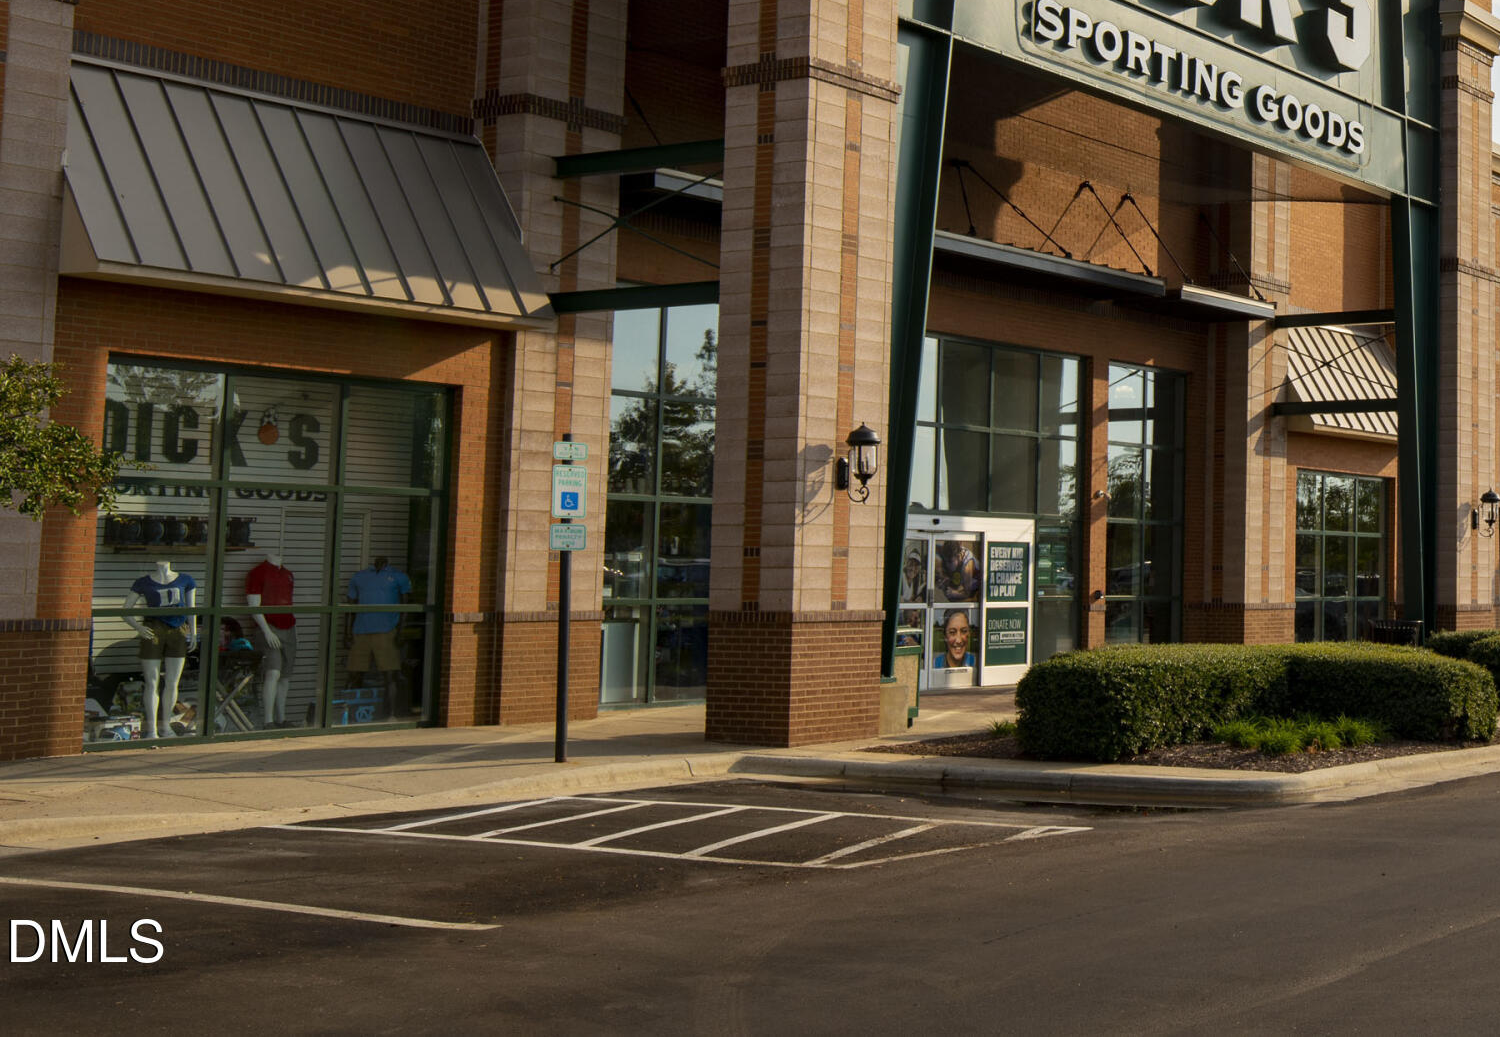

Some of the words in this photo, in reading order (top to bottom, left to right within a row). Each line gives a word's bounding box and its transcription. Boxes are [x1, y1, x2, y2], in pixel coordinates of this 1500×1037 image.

[1256, 84, 1366, 155] GOODS
[991, 547, 1011, 559] EVERY
[991, 560, 1023, 572] DESERVES
[990, 572, 995, 584] A
[996, 573, 1023, 584] CHANCE
[991, 585, 999, 597] TO
[999, 585, 1016, 597] PLAY
[988, 619, 1009, 630] DONATE
[1009, 618, 1022, 629] NOW
